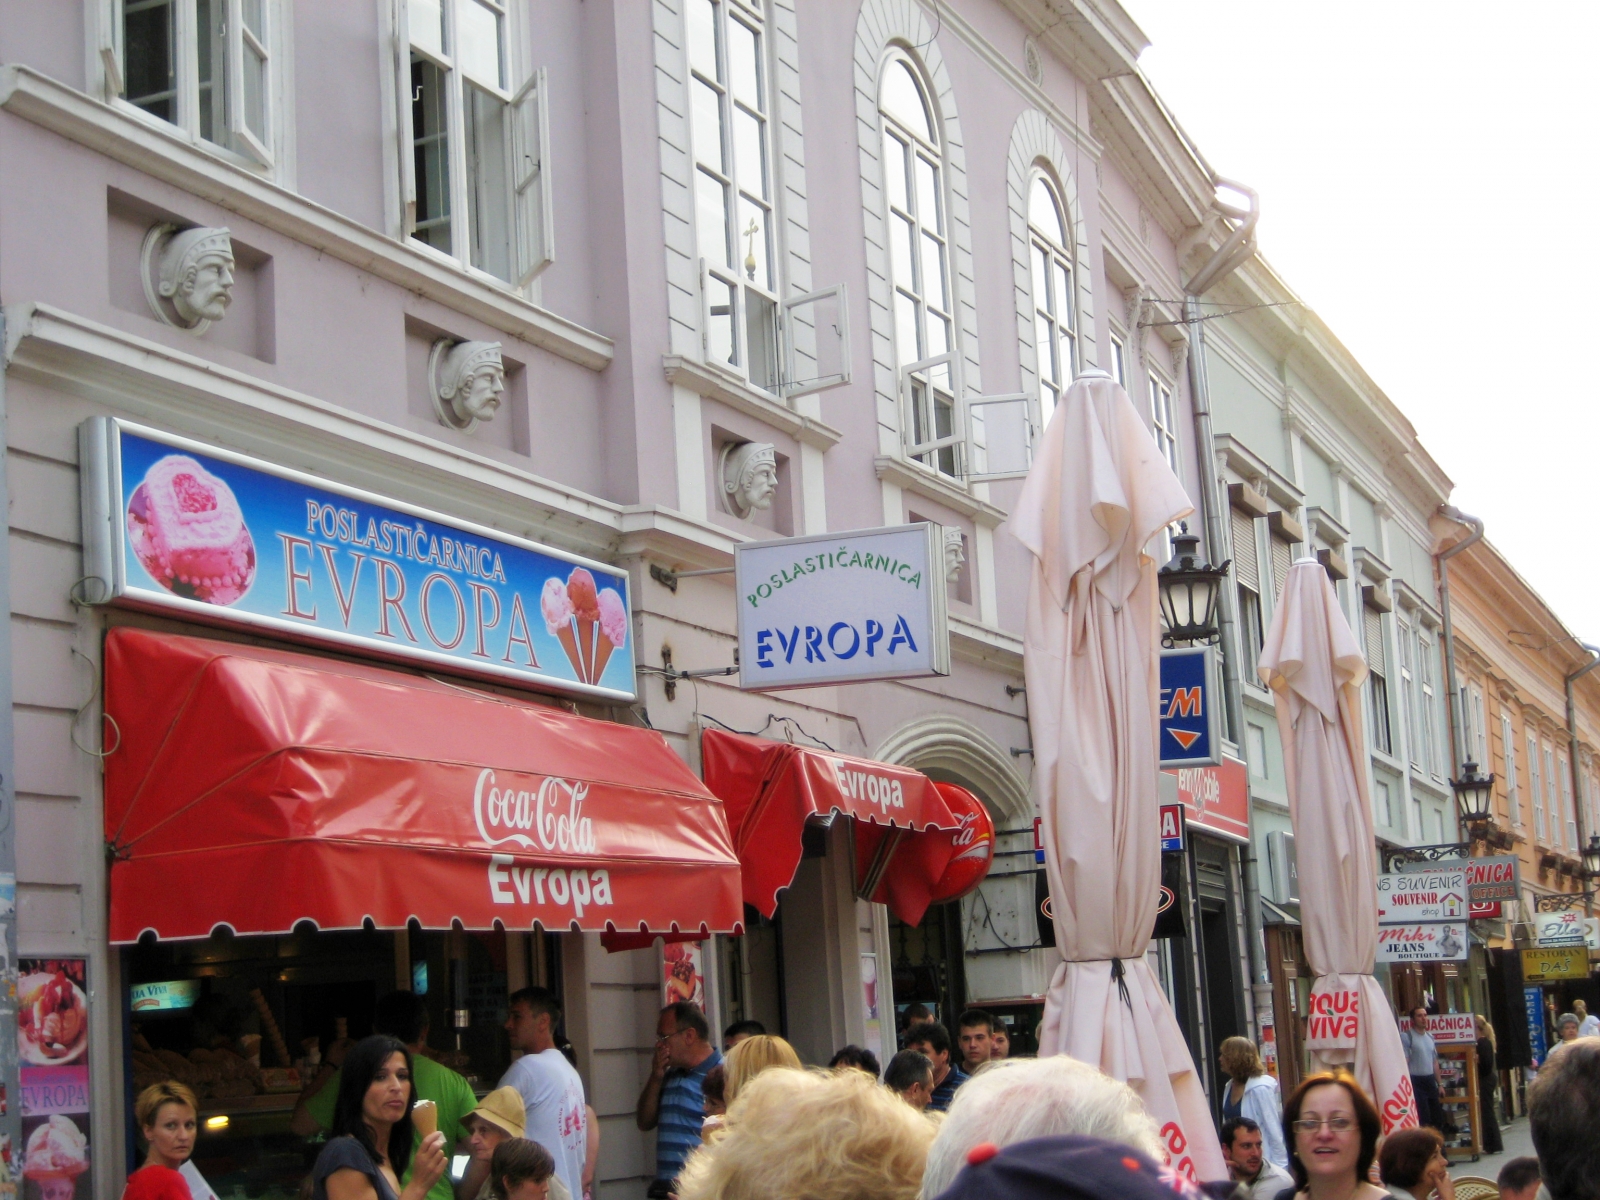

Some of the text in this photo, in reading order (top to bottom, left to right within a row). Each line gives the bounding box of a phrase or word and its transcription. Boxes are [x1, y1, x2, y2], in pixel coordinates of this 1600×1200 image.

[306, 500, 506, 583] POSLASTIČARNICA
[747, 546, 921, 608] POSLASTIČARNICA
[277, 533, 541, 669] EVROPA
[756, 613, 918, 669] EVROPA
[833, 760, 904, 814] Evropa
[488, 853, 613, 918] Evropa
[1397, 874, 1462, 892] SUVENIR
[1471, 886, 1516, 899] OFFICE
[1391, 892, 1439, 906] SOUVENIR
[1378, 926, 1436, 943] Miki
[1386, 943, 1425, 953] JEANS
[1526, 950, 1582, 959] RESTORAN
[1401, 1014, 1473, 1032] MJAČNICA
[20, 1085, 87, 1109] EVROPA
